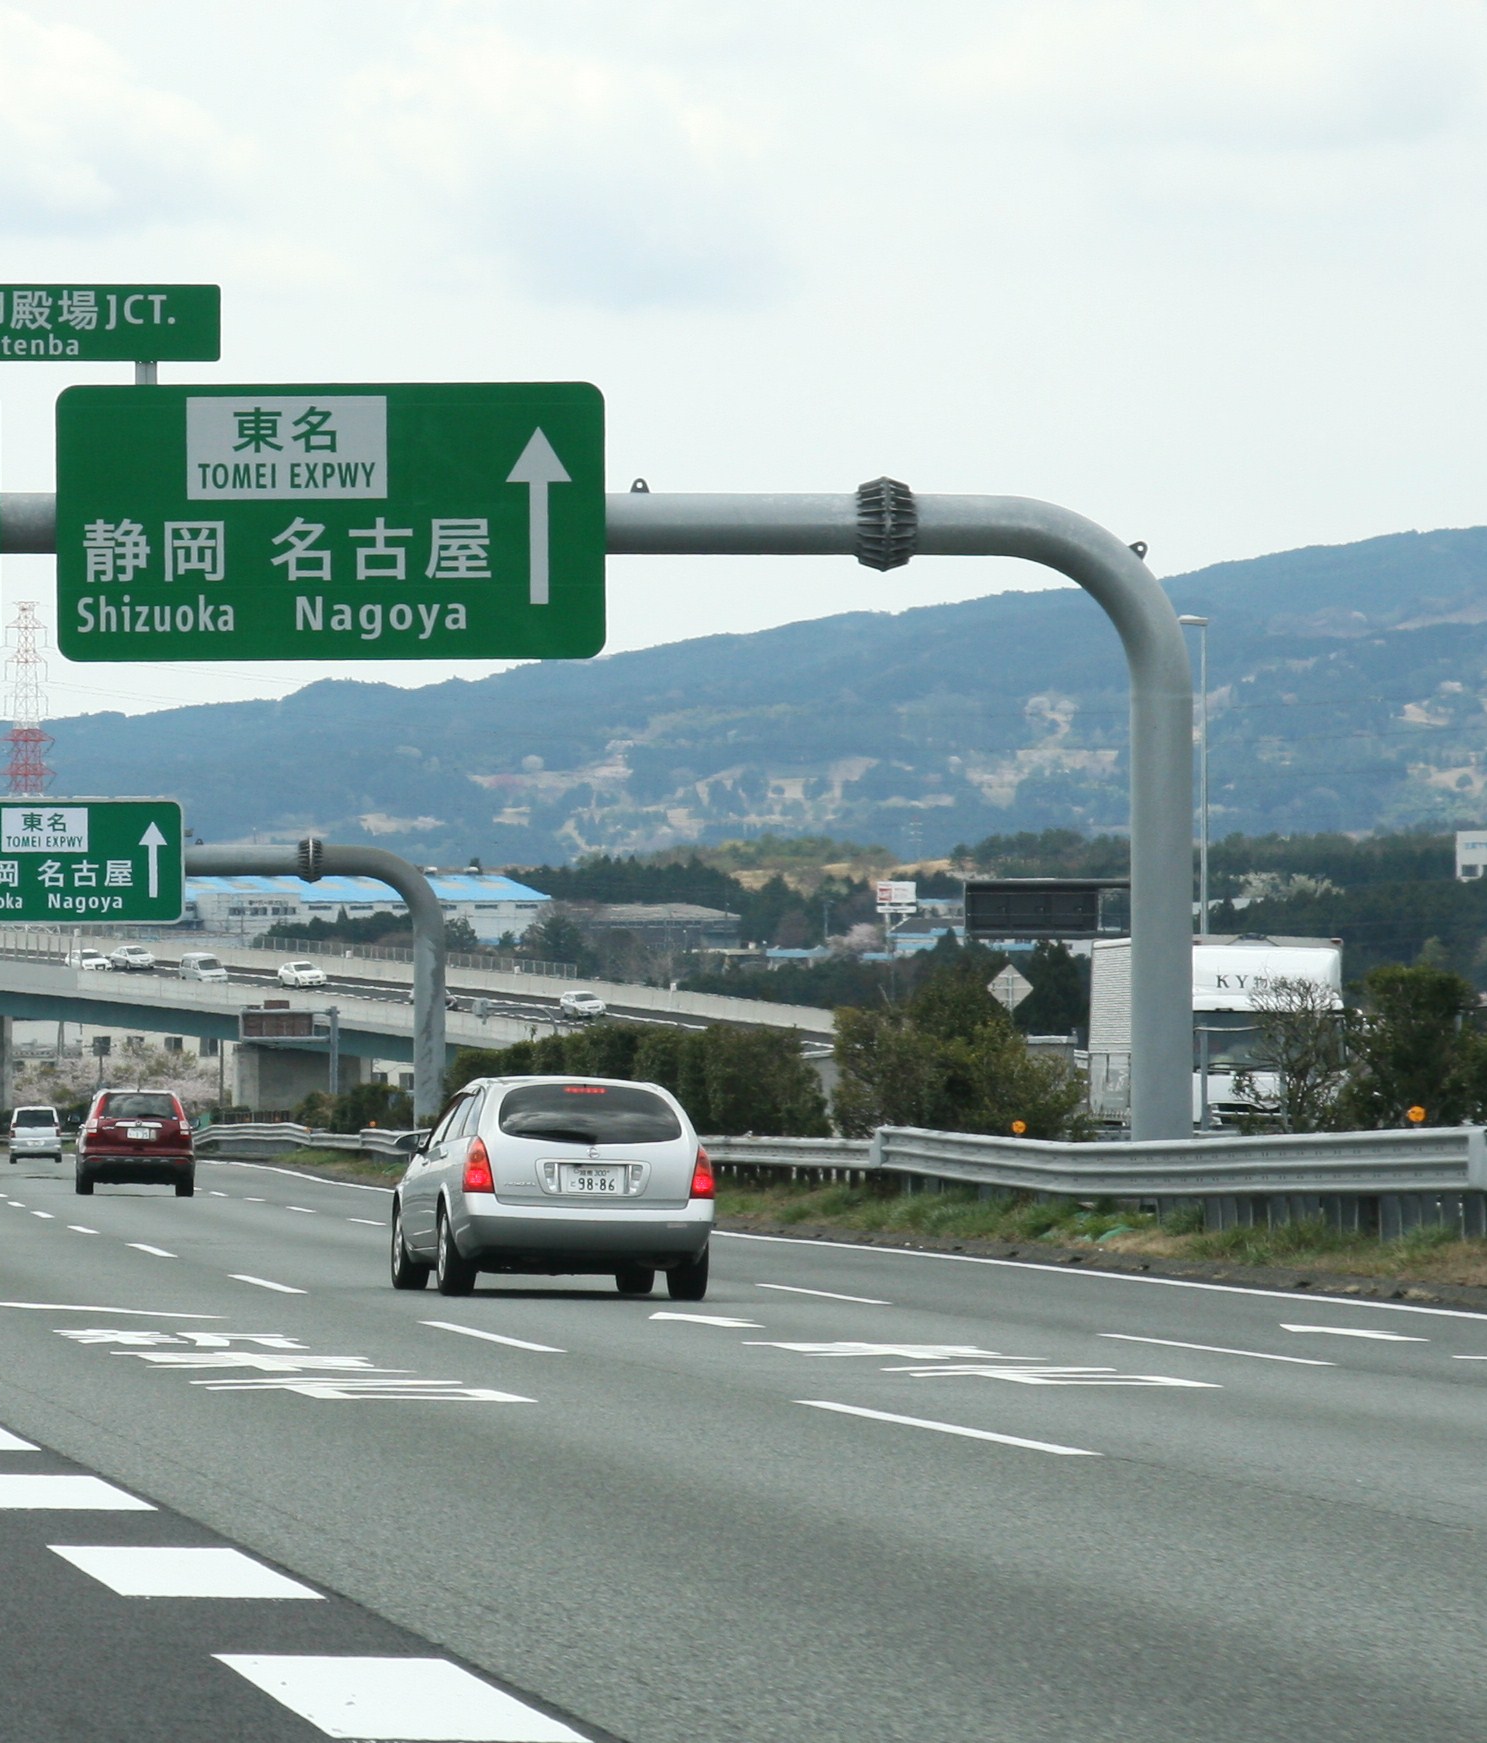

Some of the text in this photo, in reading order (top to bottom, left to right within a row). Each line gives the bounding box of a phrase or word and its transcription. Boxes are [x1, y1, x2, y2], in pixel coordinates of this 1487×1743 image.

[232, 405, 338, 454] 東名
[197, 461, 376, 490] TOMEI EXPWY
[83, 516, 493, 583] 静岡 名古屋
[76, 595, 468, 640] Shizuoka Nagoya
[21, 812, 68, 833] 東名
[6, 836, 84, 848] TOMEI EXPWY
[37, 859, 134, 888] 名古屋
[47, 893, 123, 913] Nagoya
[578, 1178, 615, 1191] 98-86
